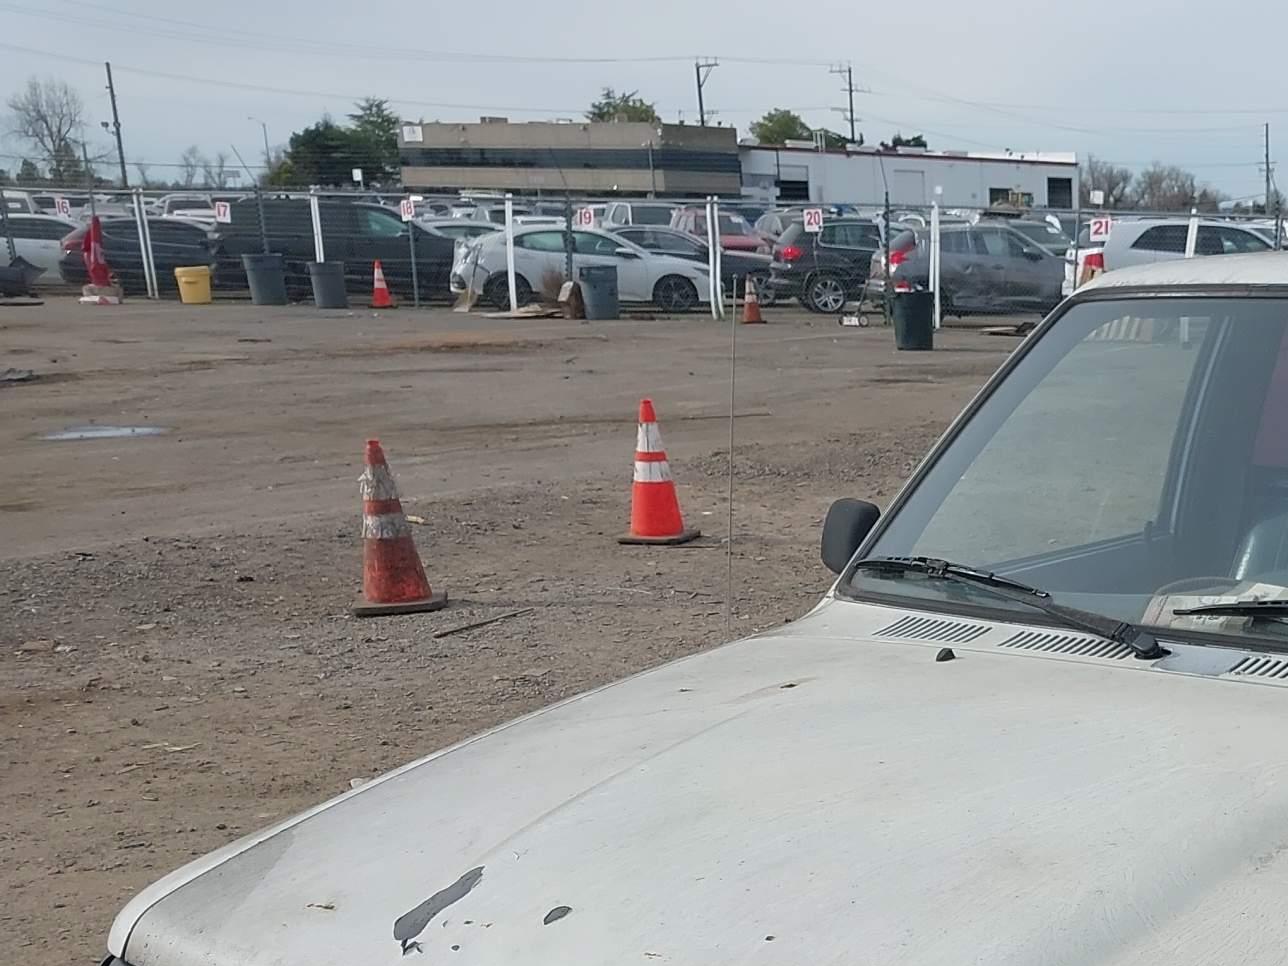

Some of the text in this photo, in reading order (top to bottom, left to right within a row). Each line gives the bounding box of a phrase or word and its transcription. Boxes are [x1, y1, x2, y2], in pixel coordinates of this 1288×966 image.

[56, 200, 69, 215] 16
[216, 203, 228, 217] 17
[402, 201, 413, 216] 18
[579, 209, 592, 225] 19
[806, 211, 821, 226] 20
[1093, 220, 1109, 236] 21
